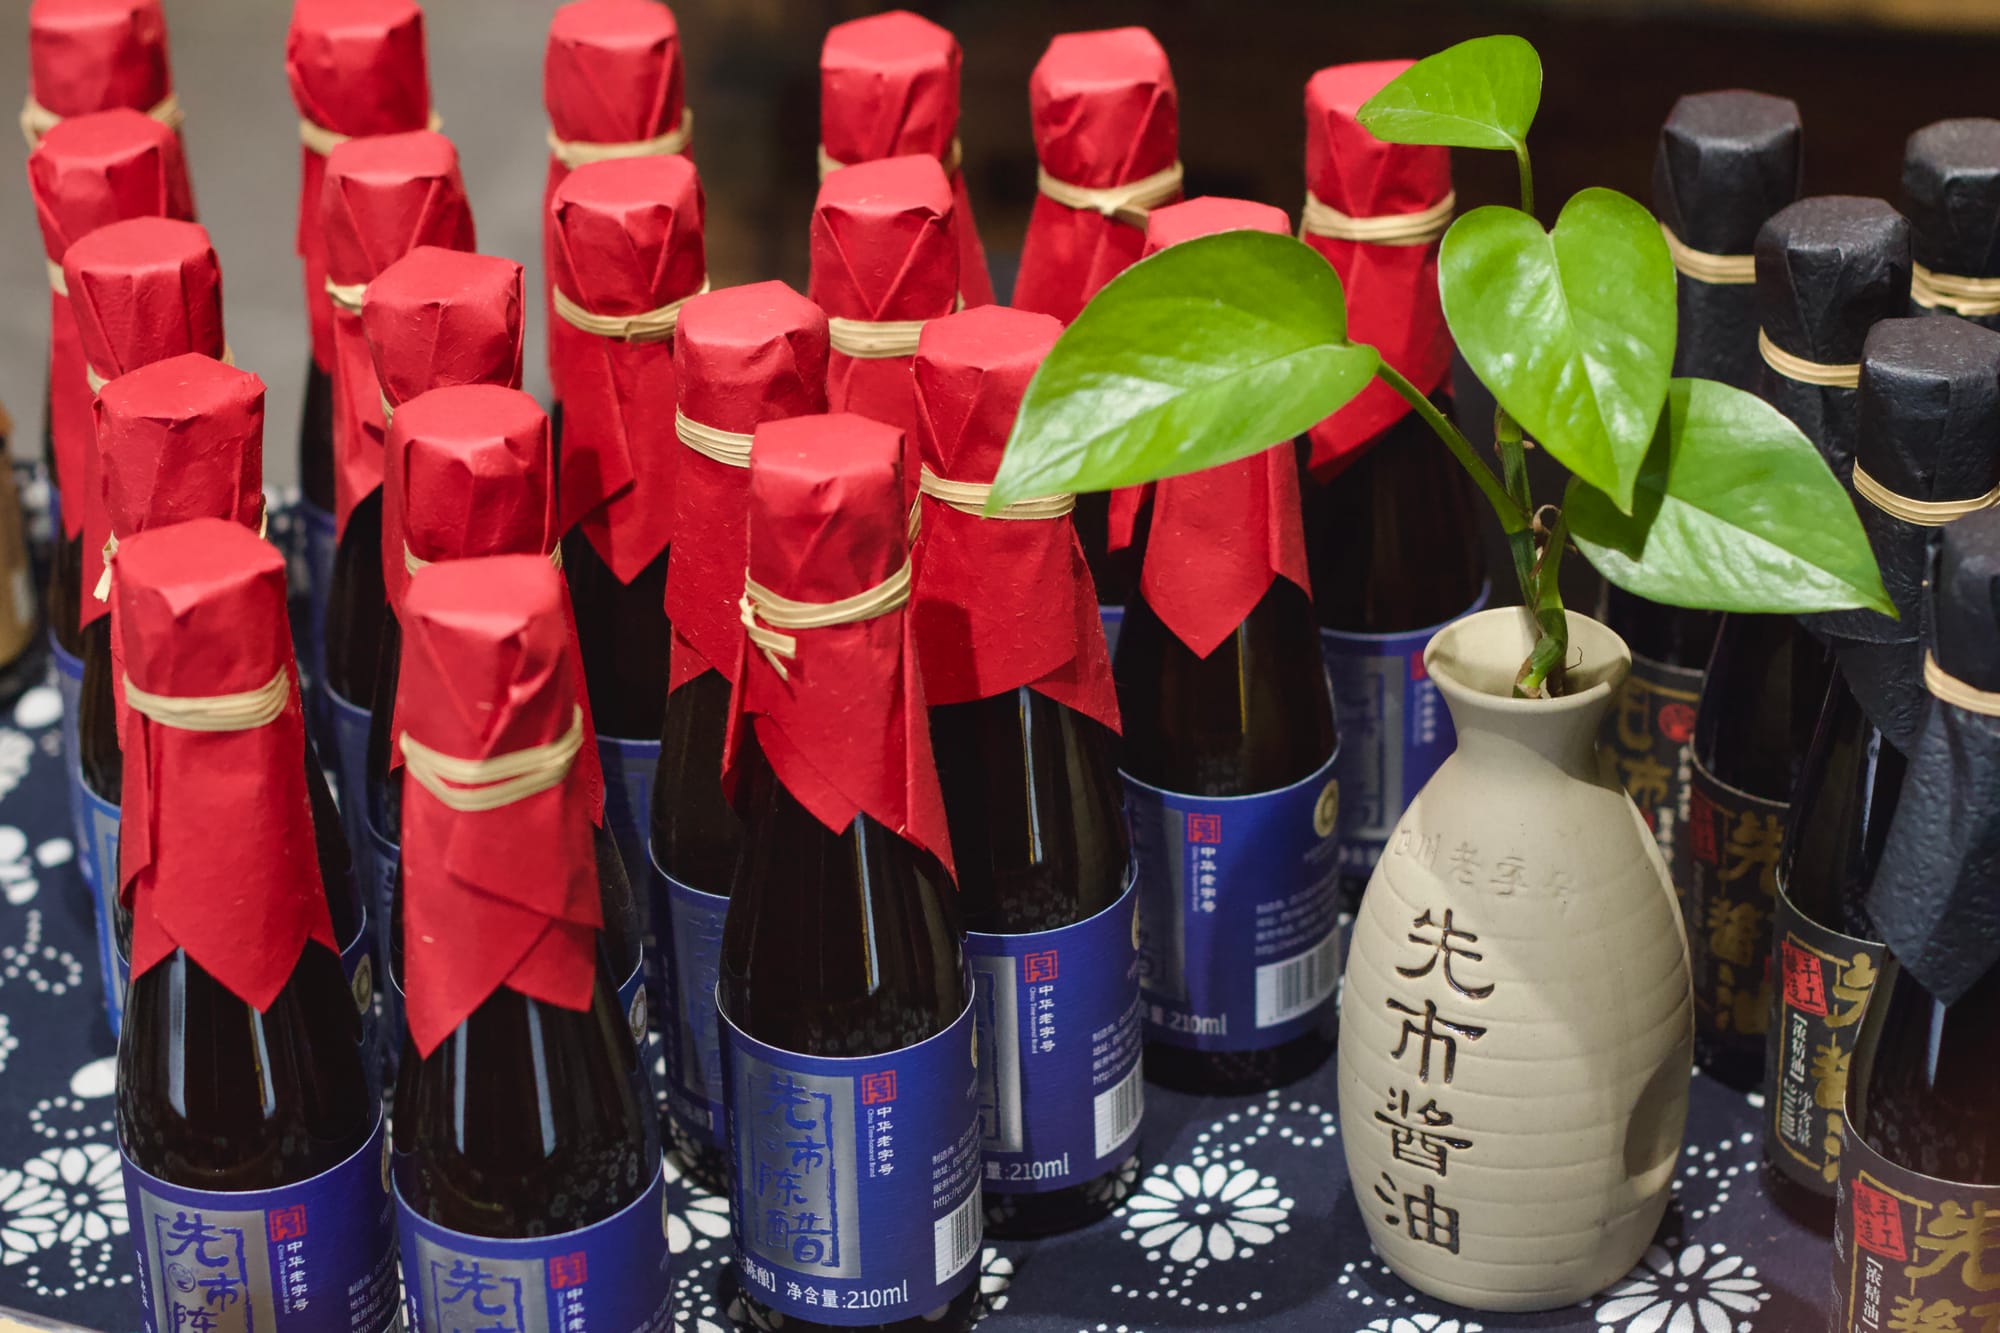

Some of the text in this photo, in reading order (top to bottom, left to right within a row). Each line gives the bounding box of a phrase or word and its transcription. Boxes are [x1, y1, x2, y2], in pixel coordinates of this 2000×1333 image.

[1038, 984, 1057, 1053] 中华老字号
[1373, 907, 1496, 1256] 先市酱油
[876, 1105, 895, 1177] 中华老字号
[286, 1240, 311, 1313] 中华老字号
